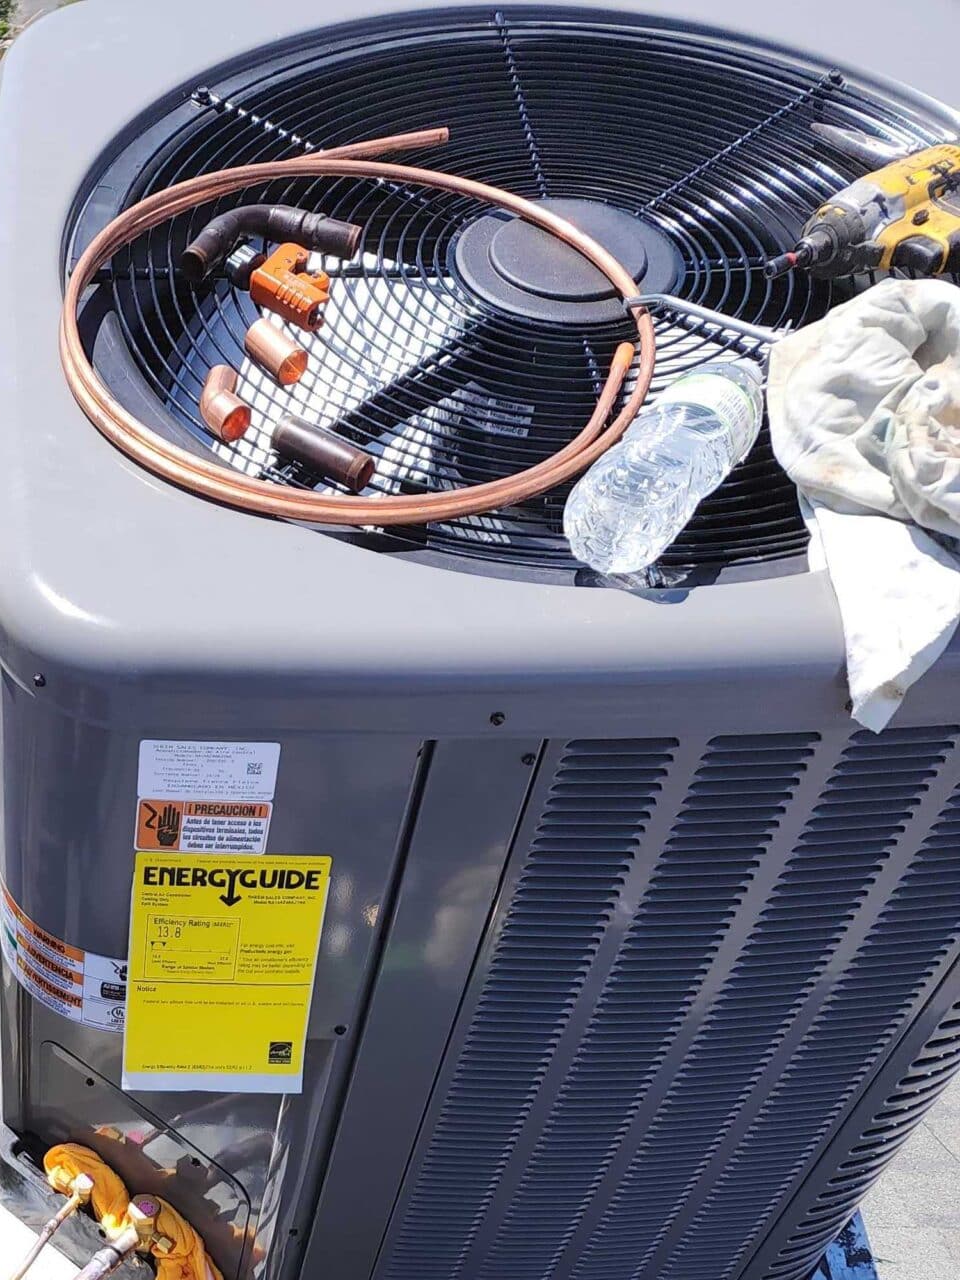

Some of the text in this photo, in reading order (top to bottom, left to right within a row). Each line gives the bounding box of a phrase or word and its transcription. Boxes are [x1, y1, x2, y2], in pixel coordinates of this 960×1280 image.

[153, 917, 187, 927] Efficiency
[188, 919, 211, 928] Rating
[157, 926, 181, 938] 13.8
